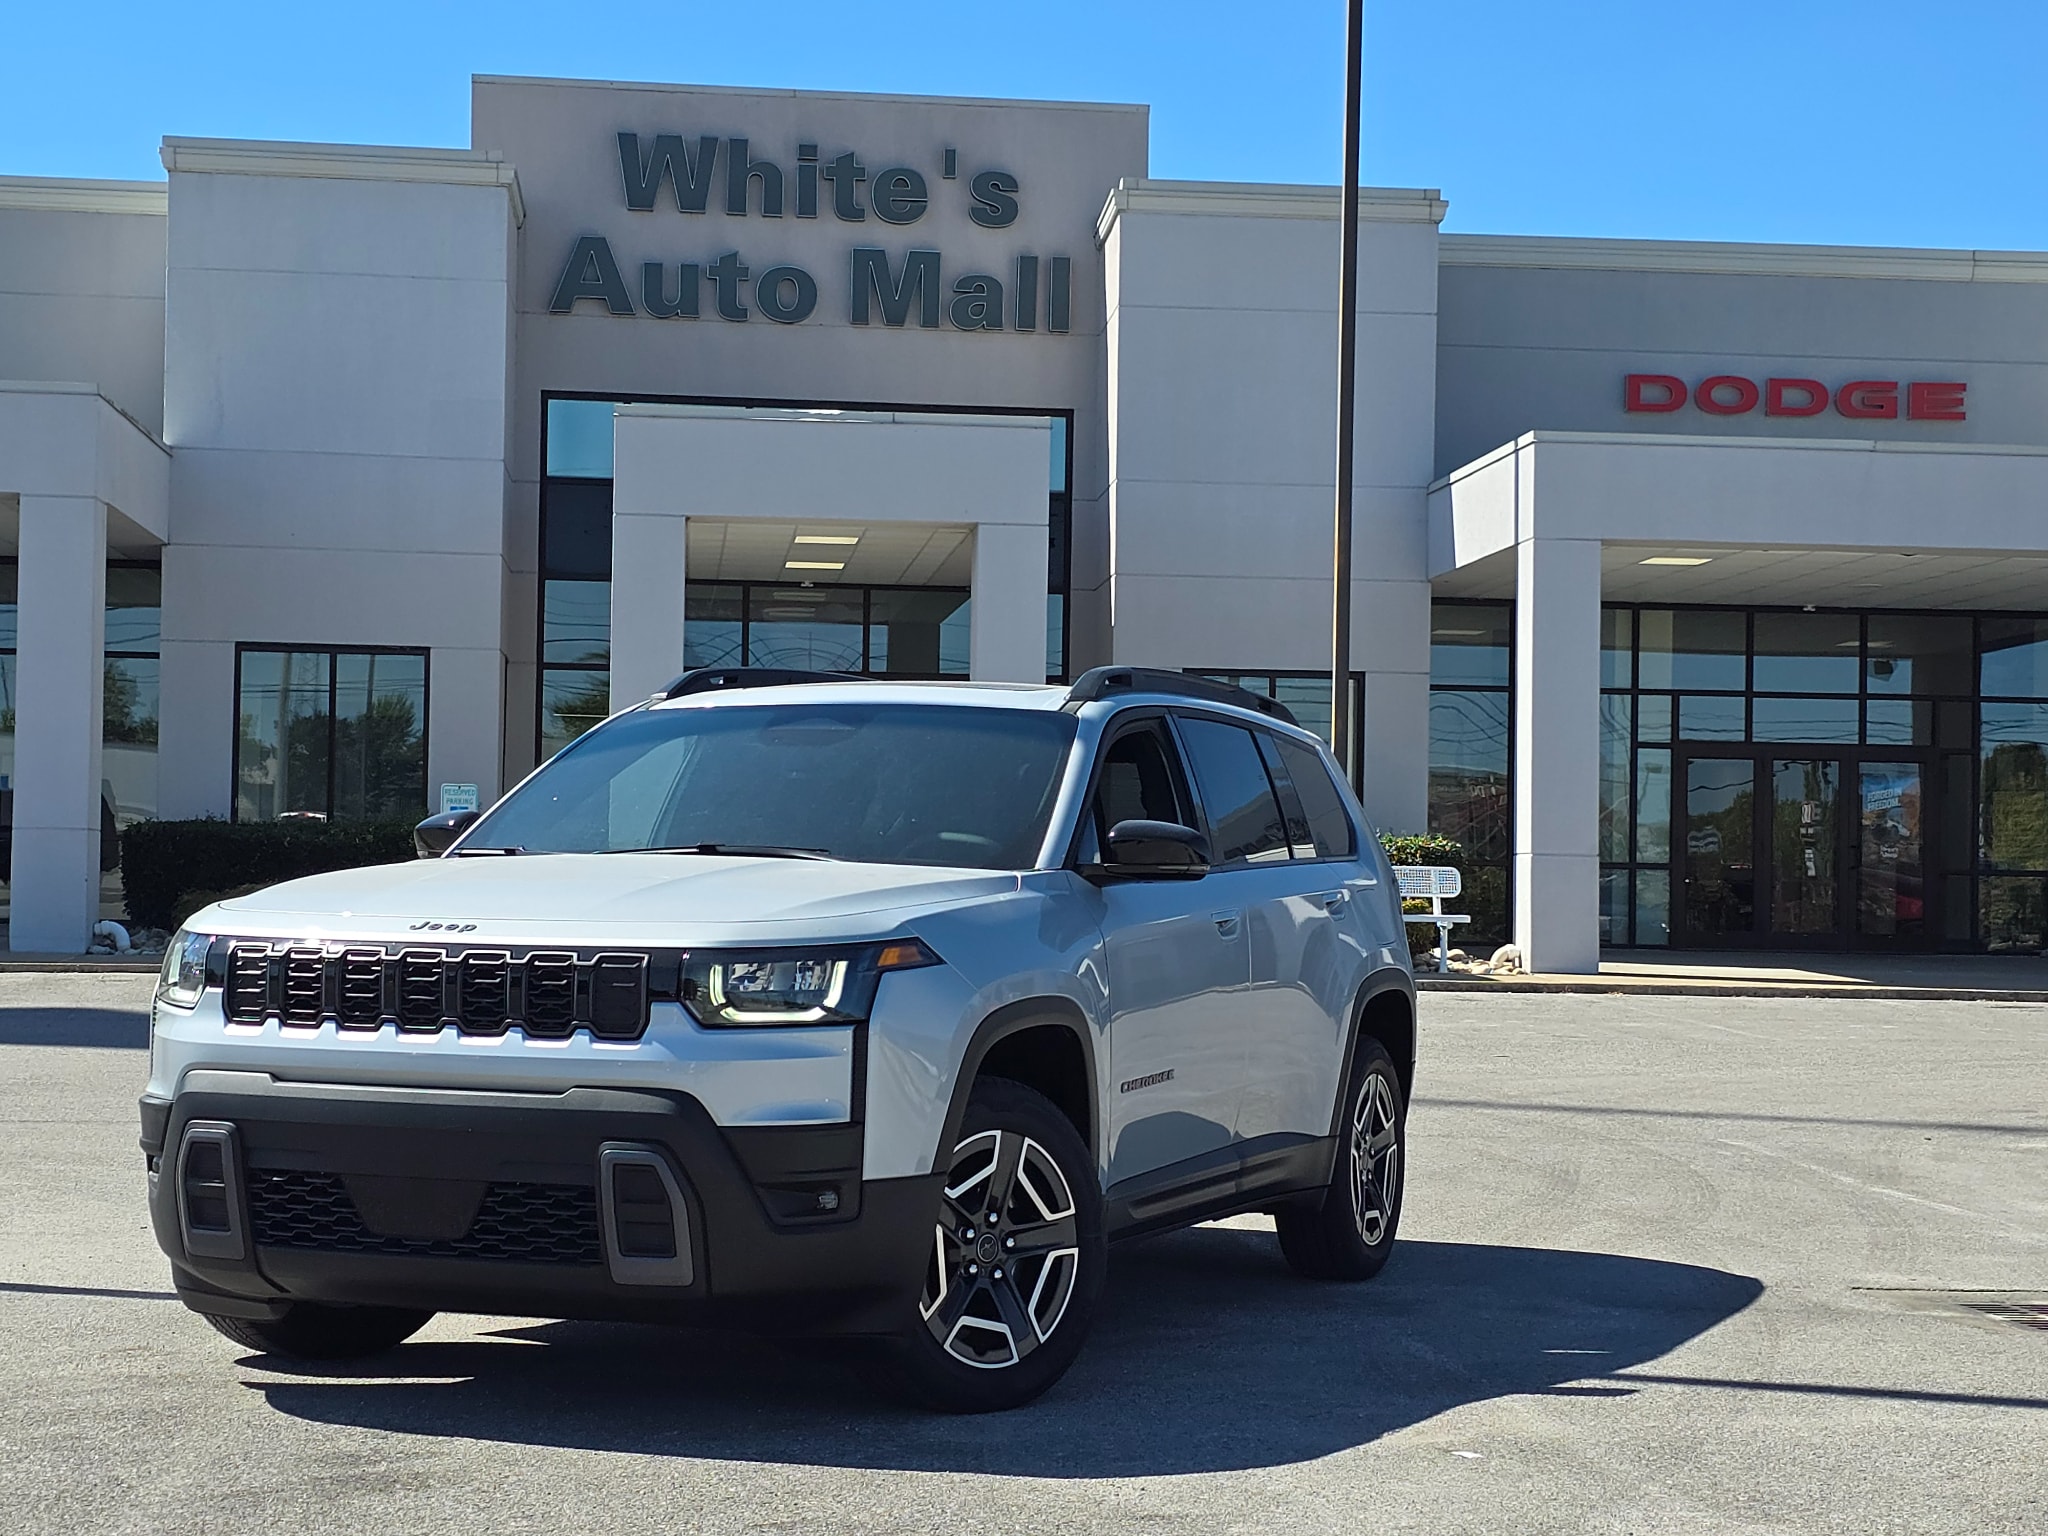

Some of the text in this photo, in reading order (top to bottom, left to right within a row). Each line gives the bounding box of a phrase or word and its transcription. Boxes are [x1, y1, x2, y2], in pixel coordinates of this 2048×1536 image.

[616, 131, 1020, 229] White's
[548, 235, 1071, 333] Auto Mall
[1624, 374, 1967, 421] DODGE
[444, 789, 476, 797] RESERVED
[409, 921, 477, 933] Jeep
[1120, 1069, 1175, 1094] CHEROKEE
